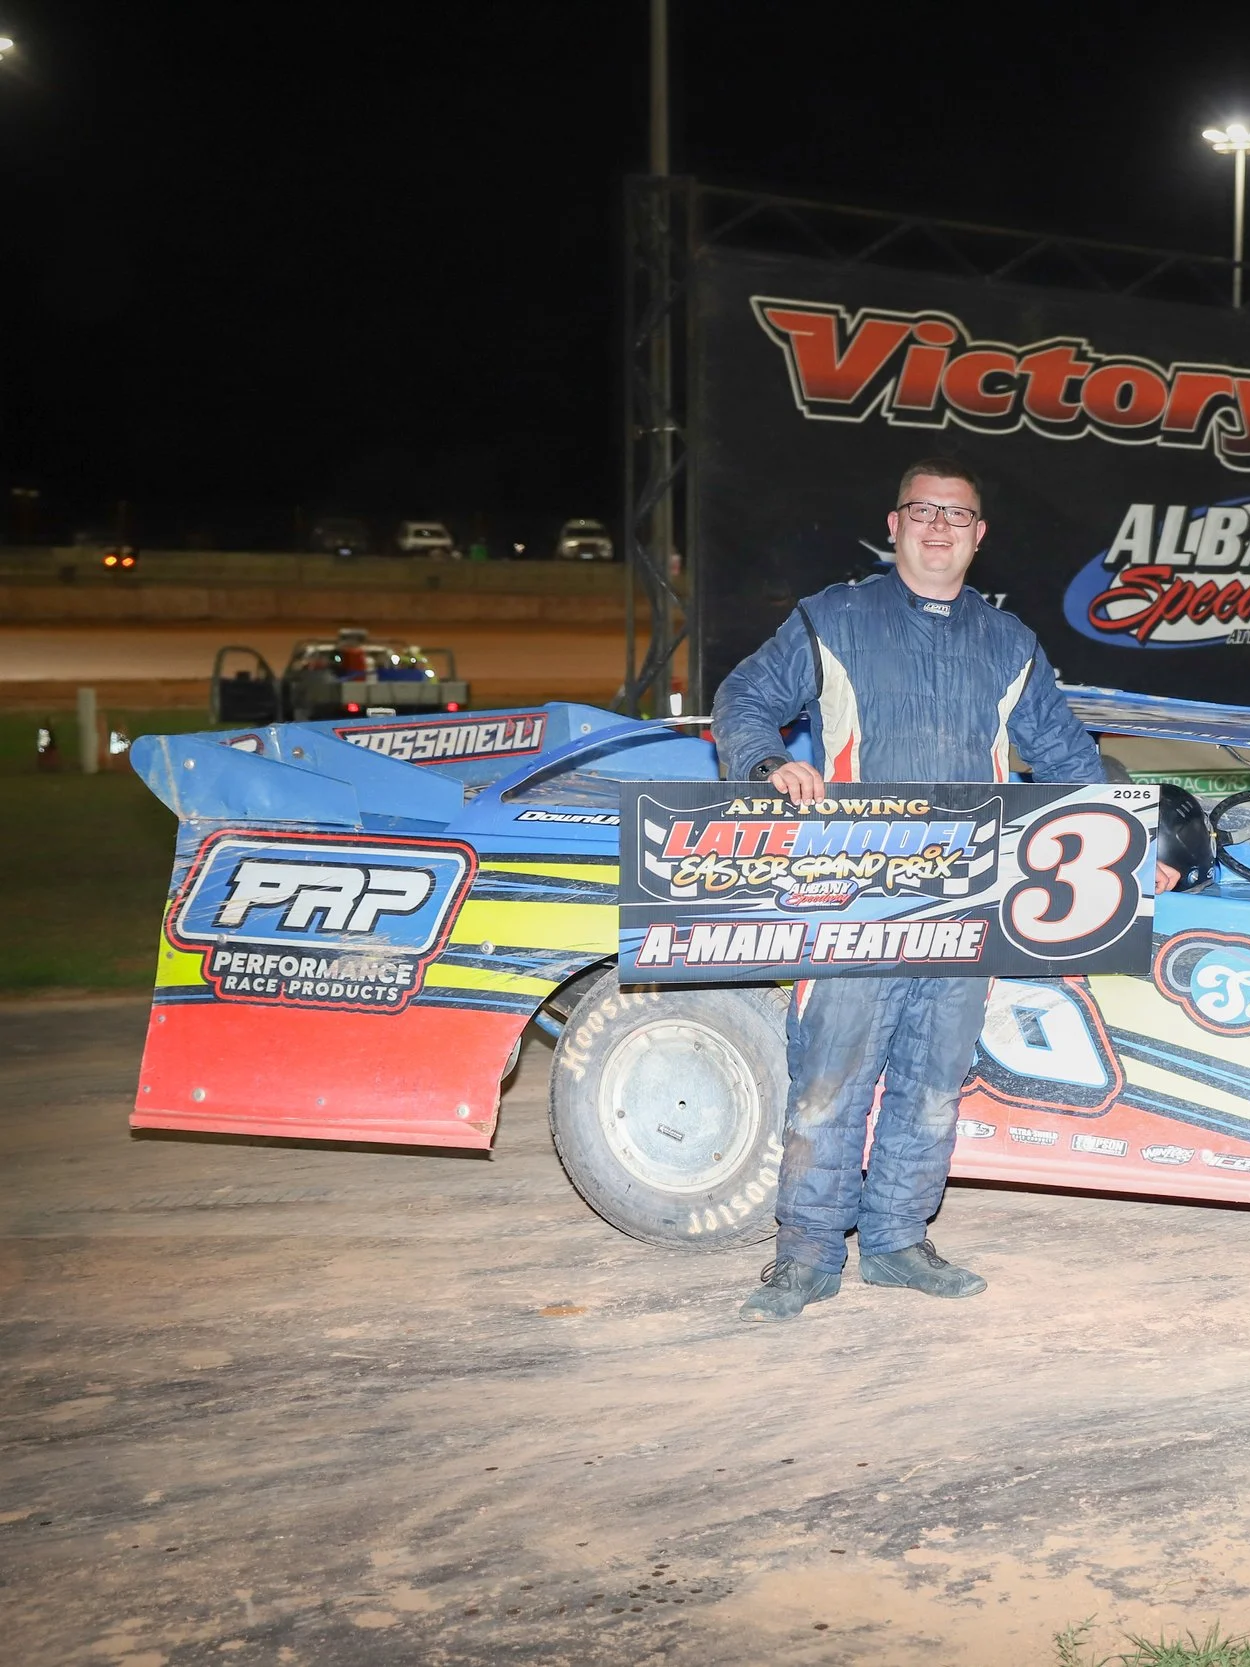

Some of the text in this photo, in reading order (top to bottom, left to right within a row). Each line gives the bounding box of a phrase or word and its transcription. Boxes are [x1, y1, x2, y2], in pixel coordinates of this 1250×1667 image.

[725, 798, 931, 816] AFI TOWING
[1113, 789, 1152, 800] 2026
[671, 851, 791, 892] EASTER
[790, 851, 887, 884] GRAND
[788, 882, 854, 895] ALBANY
[1009, 810, 1134, 945] 3
[215, 860, 434, 933] PRP
[637, 920, 989, 967] A-MAIN FEATURE
[213, 951, 414, 985] PERFORMANCE
[224, 975, 399, 1002] RACE PRODUCTS
